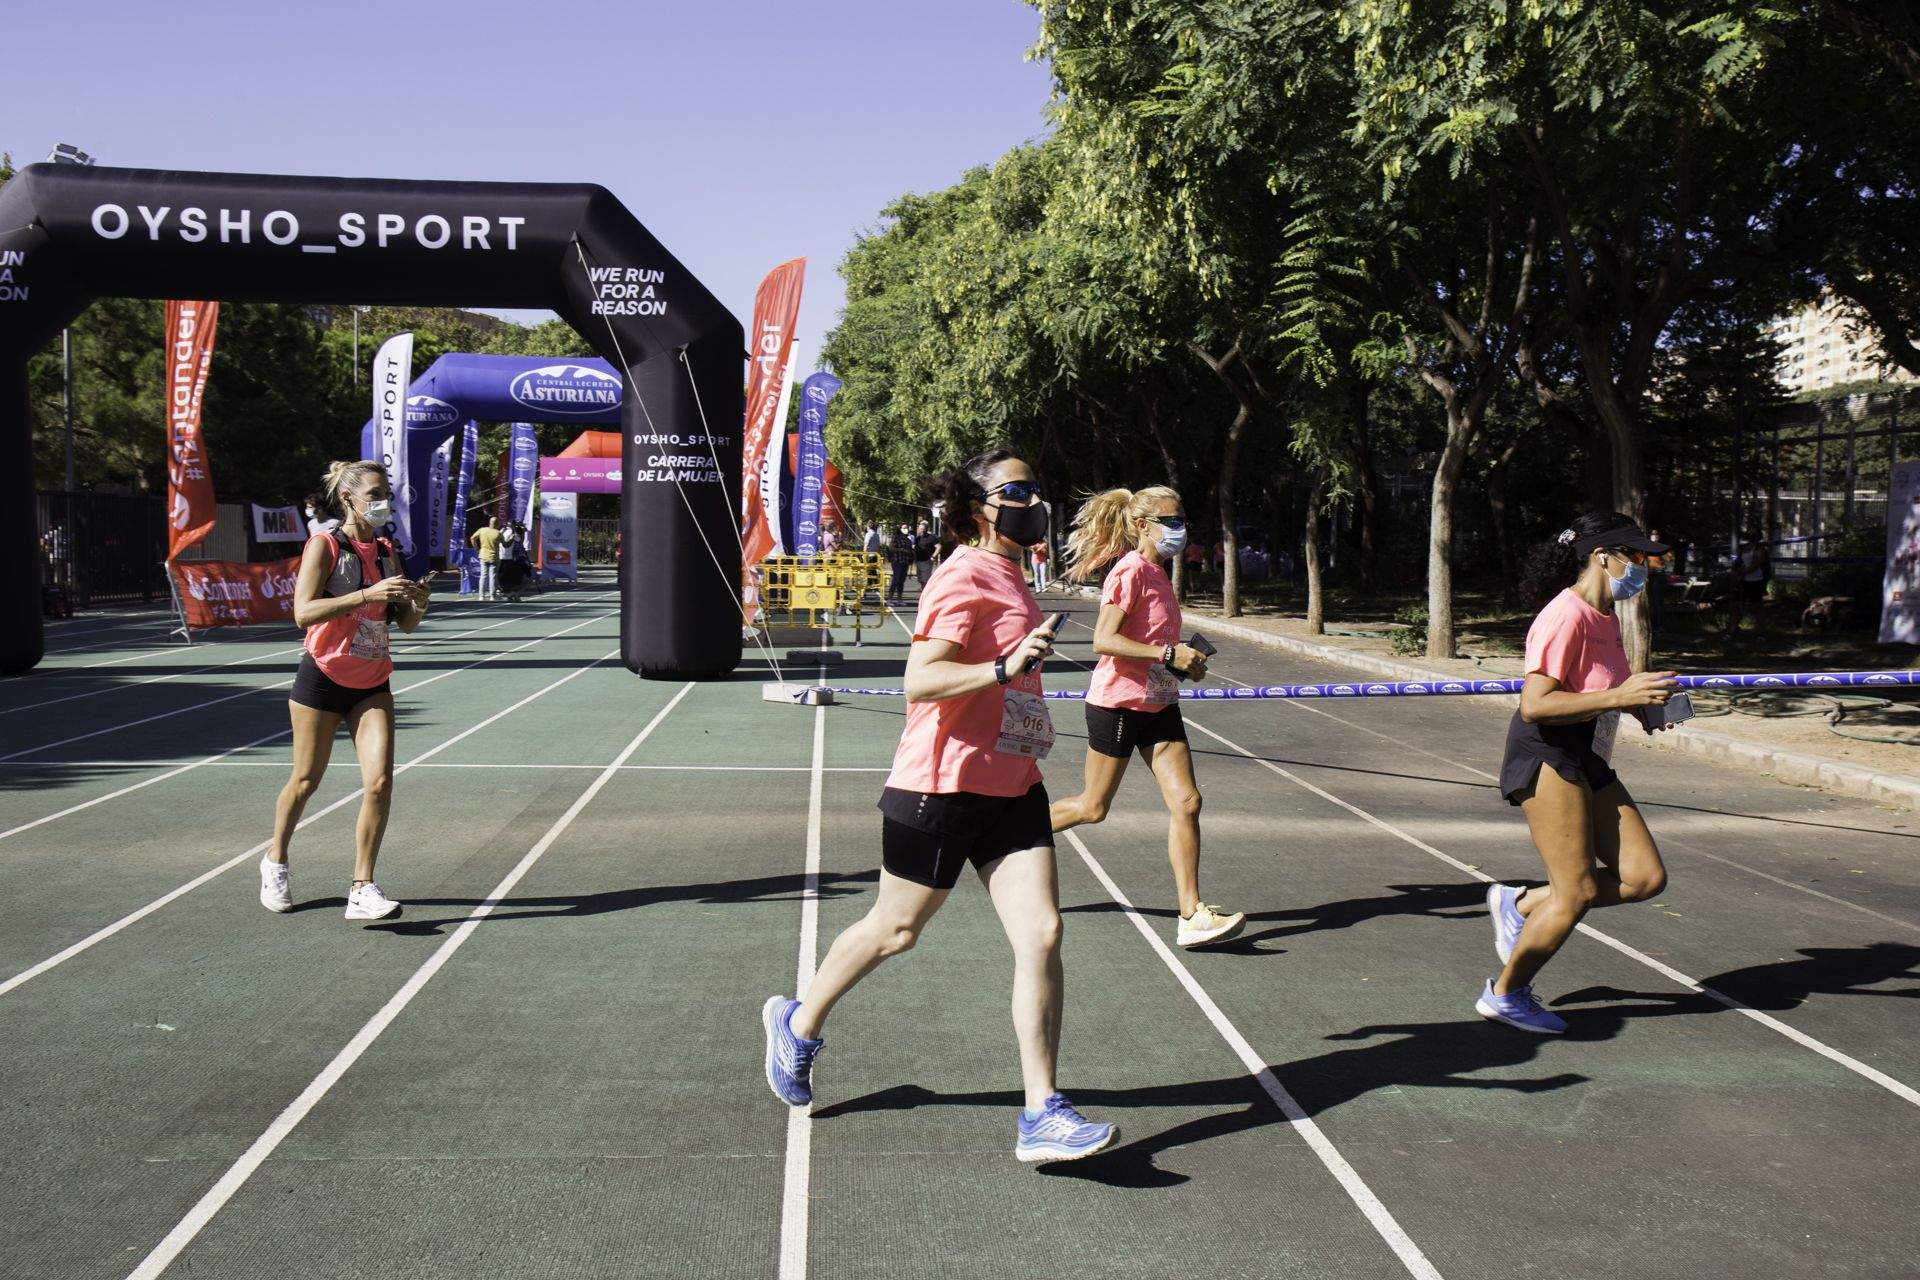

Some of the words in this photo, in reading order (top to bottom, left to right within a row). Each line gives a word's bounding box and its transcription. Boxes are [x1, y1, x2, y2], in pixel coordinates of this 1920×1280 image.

[91, 203, 525, 253] OYSHO_SPORT
[590, 267, 622, 282] WE
[625, 268, 664, 284] RUN
[600, 284, 639, 299] FOR
[641, 285, 655, 299] A
[591, 300, 667, 315] REASON
[520, 380, 617, 403] ASTURIANA
[634, 434, 730, 446] OYSHO_SPORT
[647, 455, 714, 468] CARRERA
[637, 469, 655, 482] DE
[656, 469, 677, 482] LA
[677, 470, 724, 482] MUJER
[1023, 716, 1043, 731] 016
